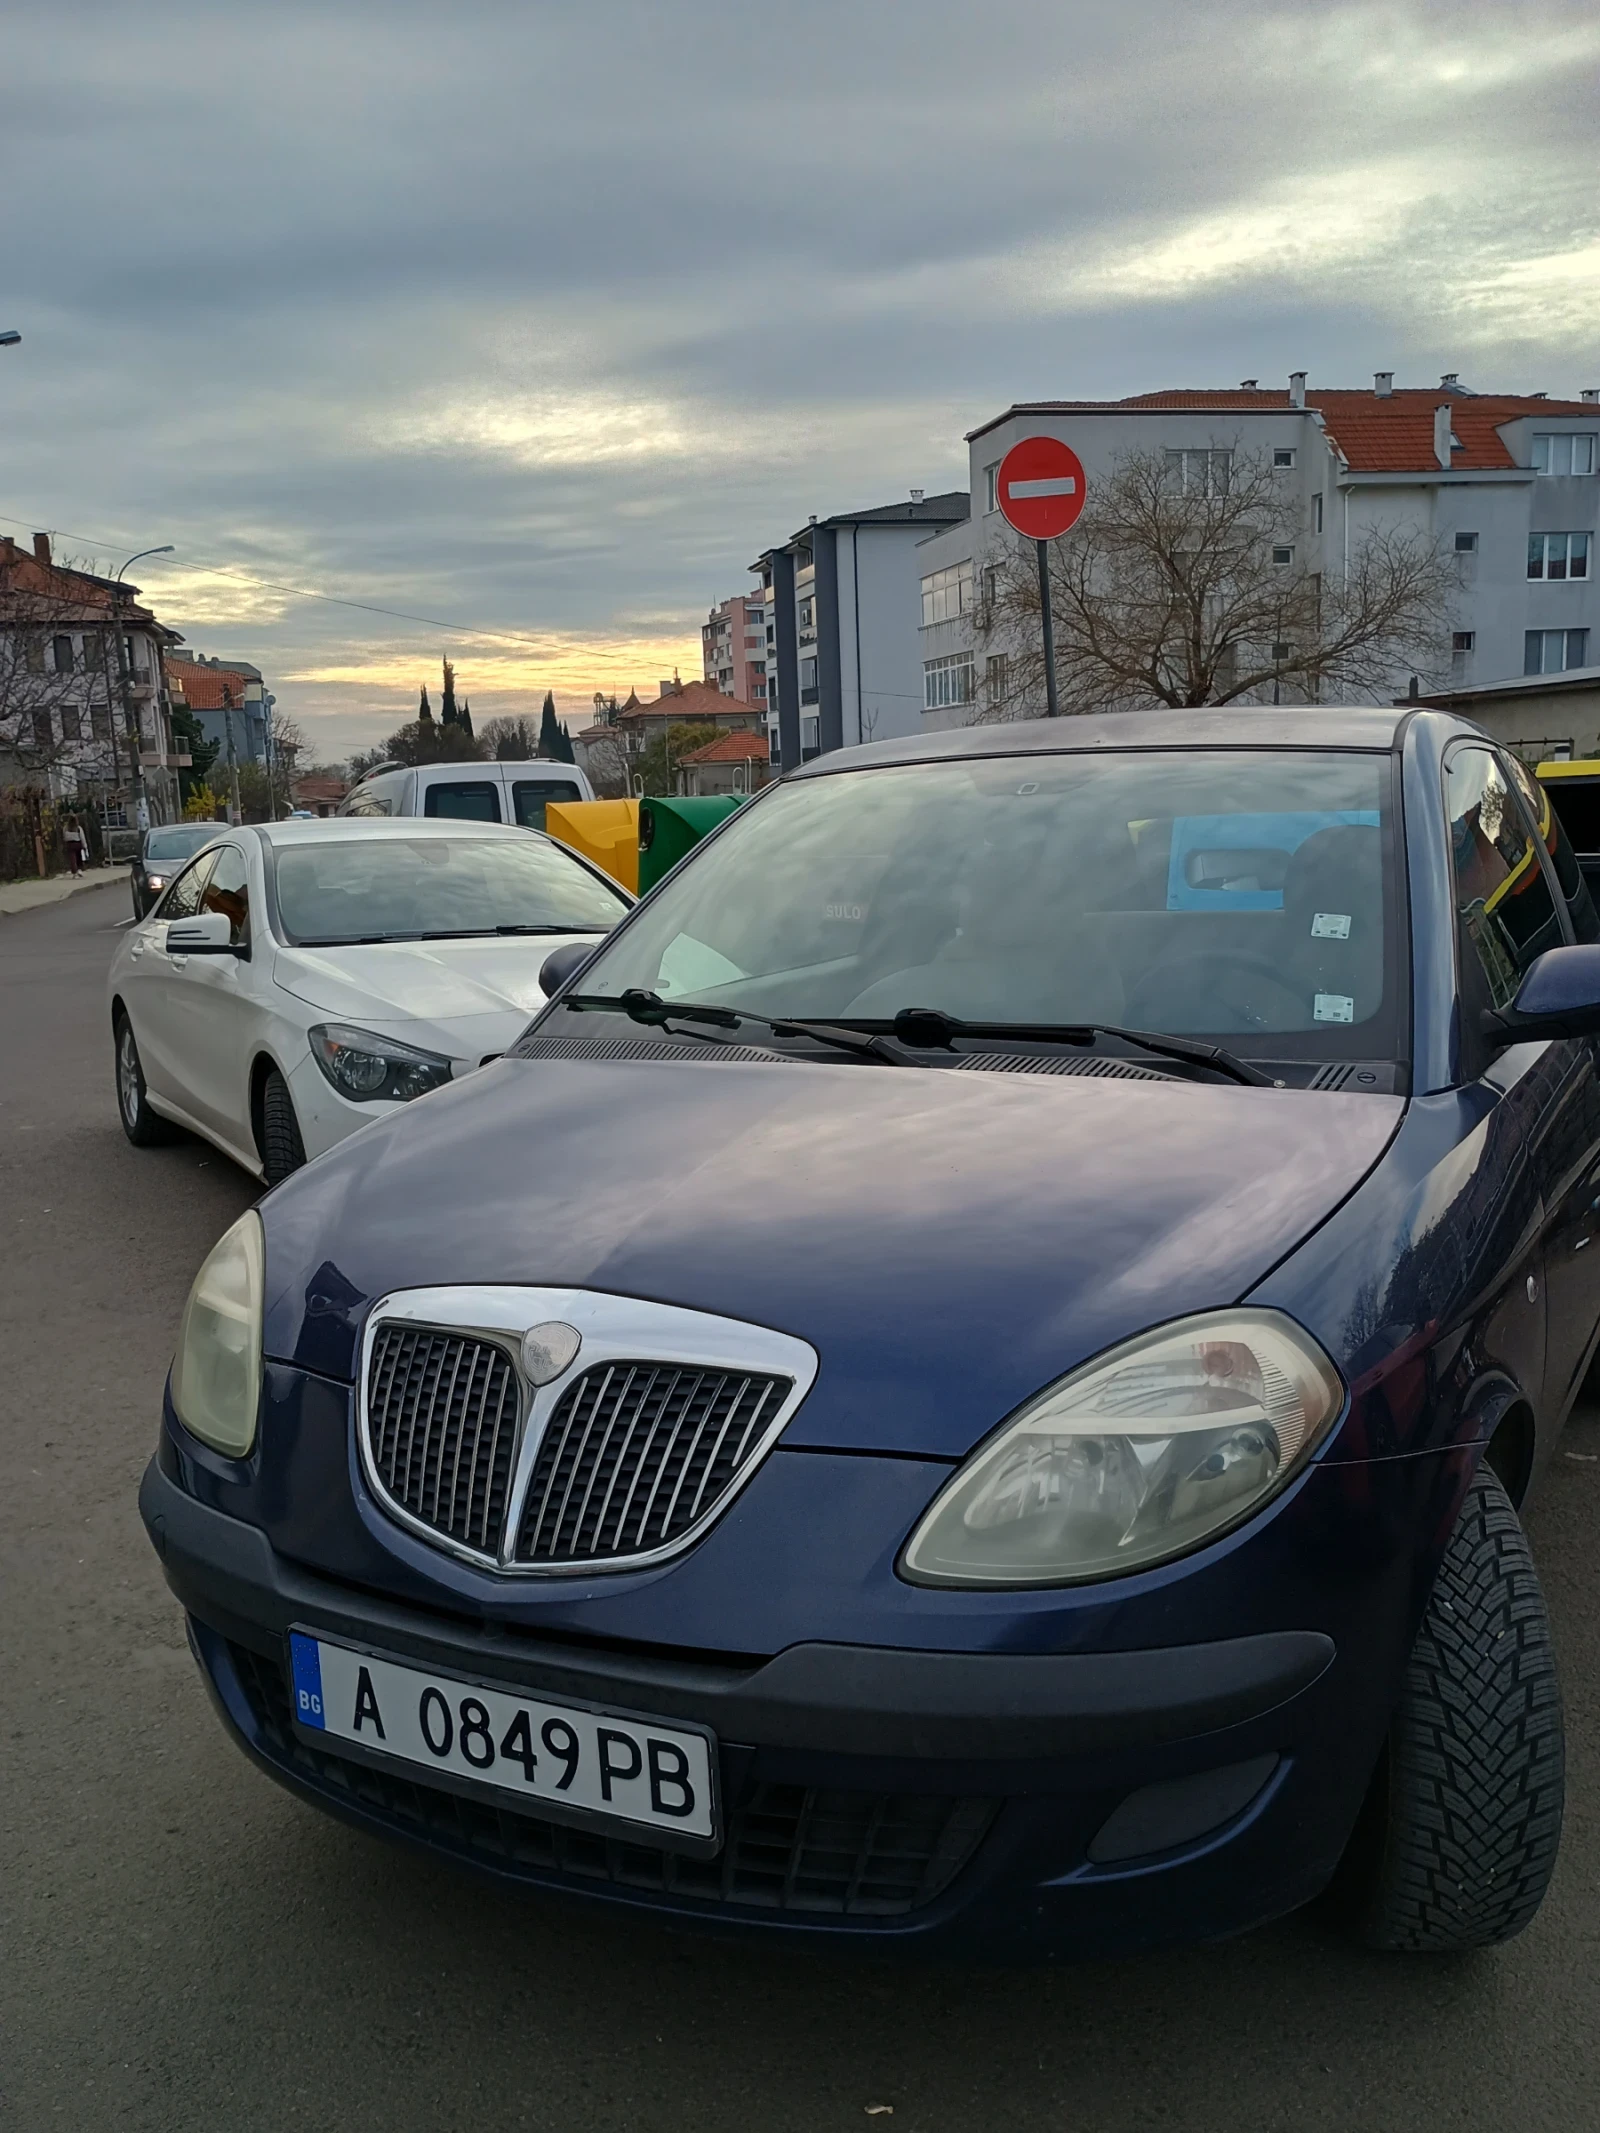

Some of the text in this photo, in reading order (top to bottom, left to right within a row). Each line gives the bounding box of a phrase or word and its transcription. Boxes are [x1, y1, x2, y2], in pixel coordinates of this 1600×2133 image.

[826, 904, 861, 920] SULO
[299, 1689, 322, 1714] BG
[353, 1665, 695, 1818] A 0849 PB
